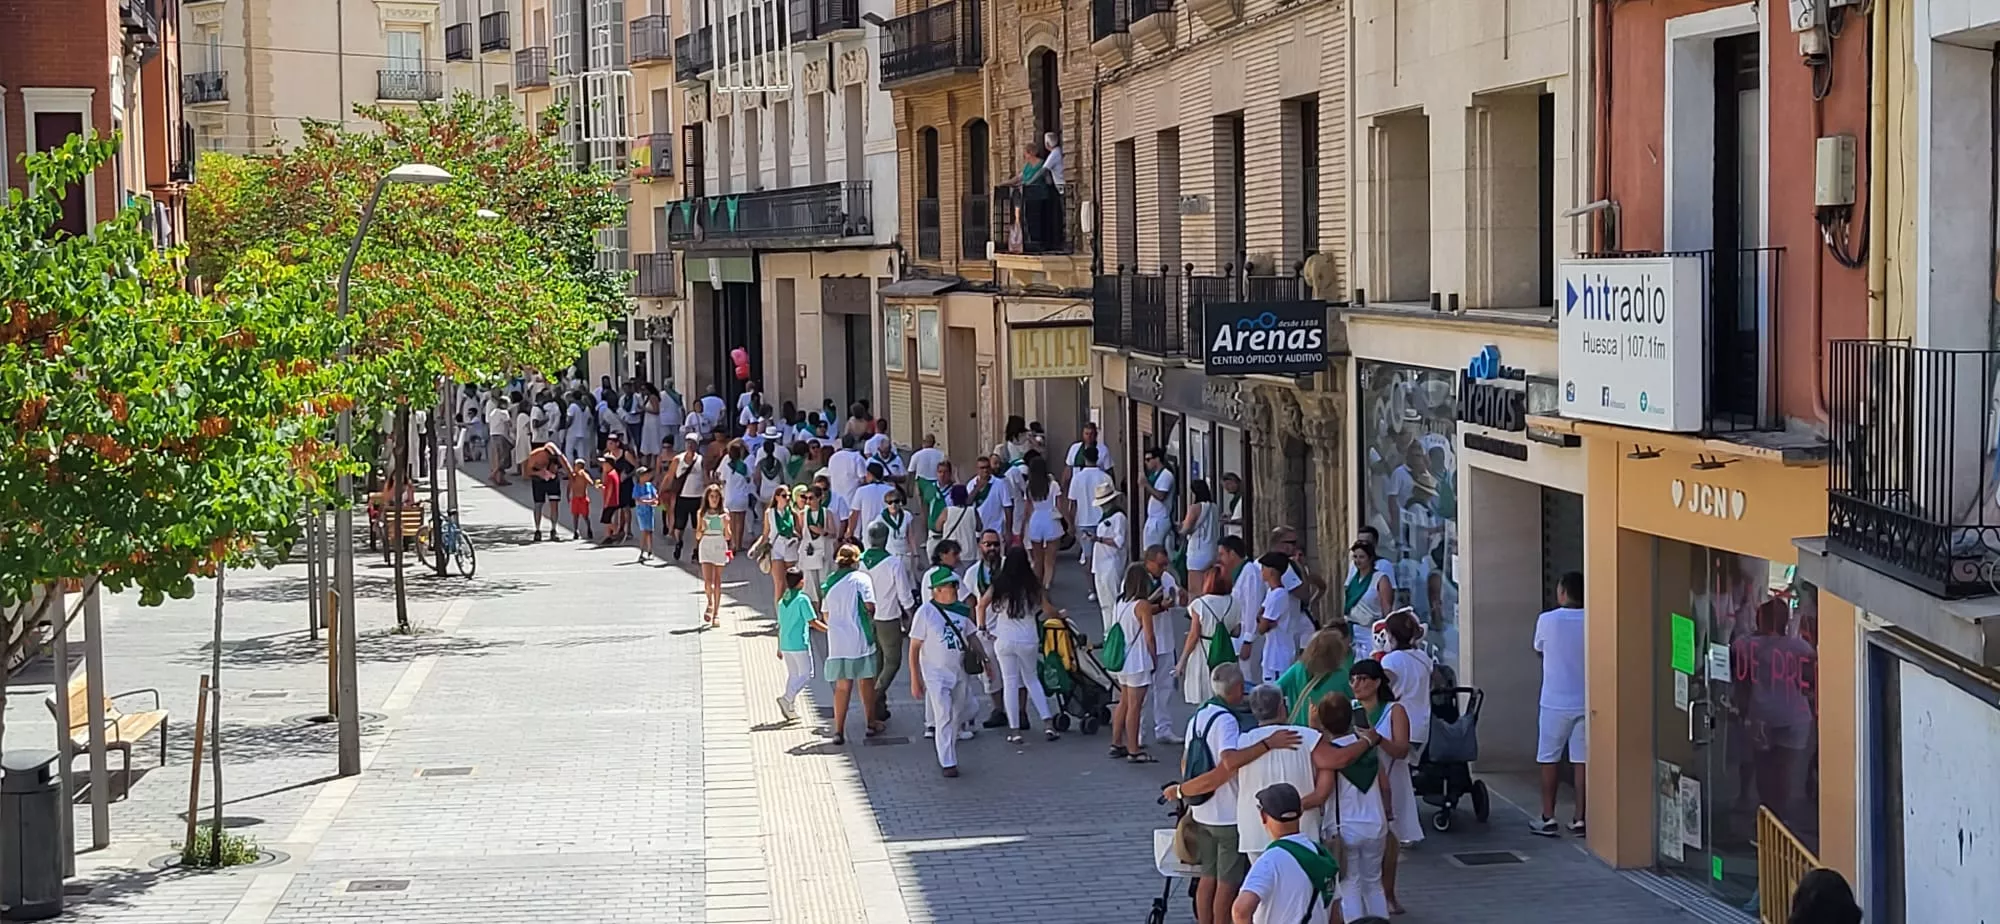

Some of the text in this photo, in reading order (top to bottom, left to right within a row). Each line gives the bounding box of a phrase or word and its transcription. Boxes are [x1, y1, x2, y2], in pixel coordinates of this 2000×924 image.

[1583, 273, 1665, 324] hitradio
[1211, 324, 1322, 352] Arenas
[1278, 319, 1299, 328] desde
[1211, 352, 1323, 365] CENTRO ÓPTICO Y AUDITIVO
[1583, 332, 1666, 360] Huesca 107.1fm
[1457, 368, 1525, 433] Arenas
[1688, 482, 1728, 520] JCN
[1735, 640, 1760, 685] DE
